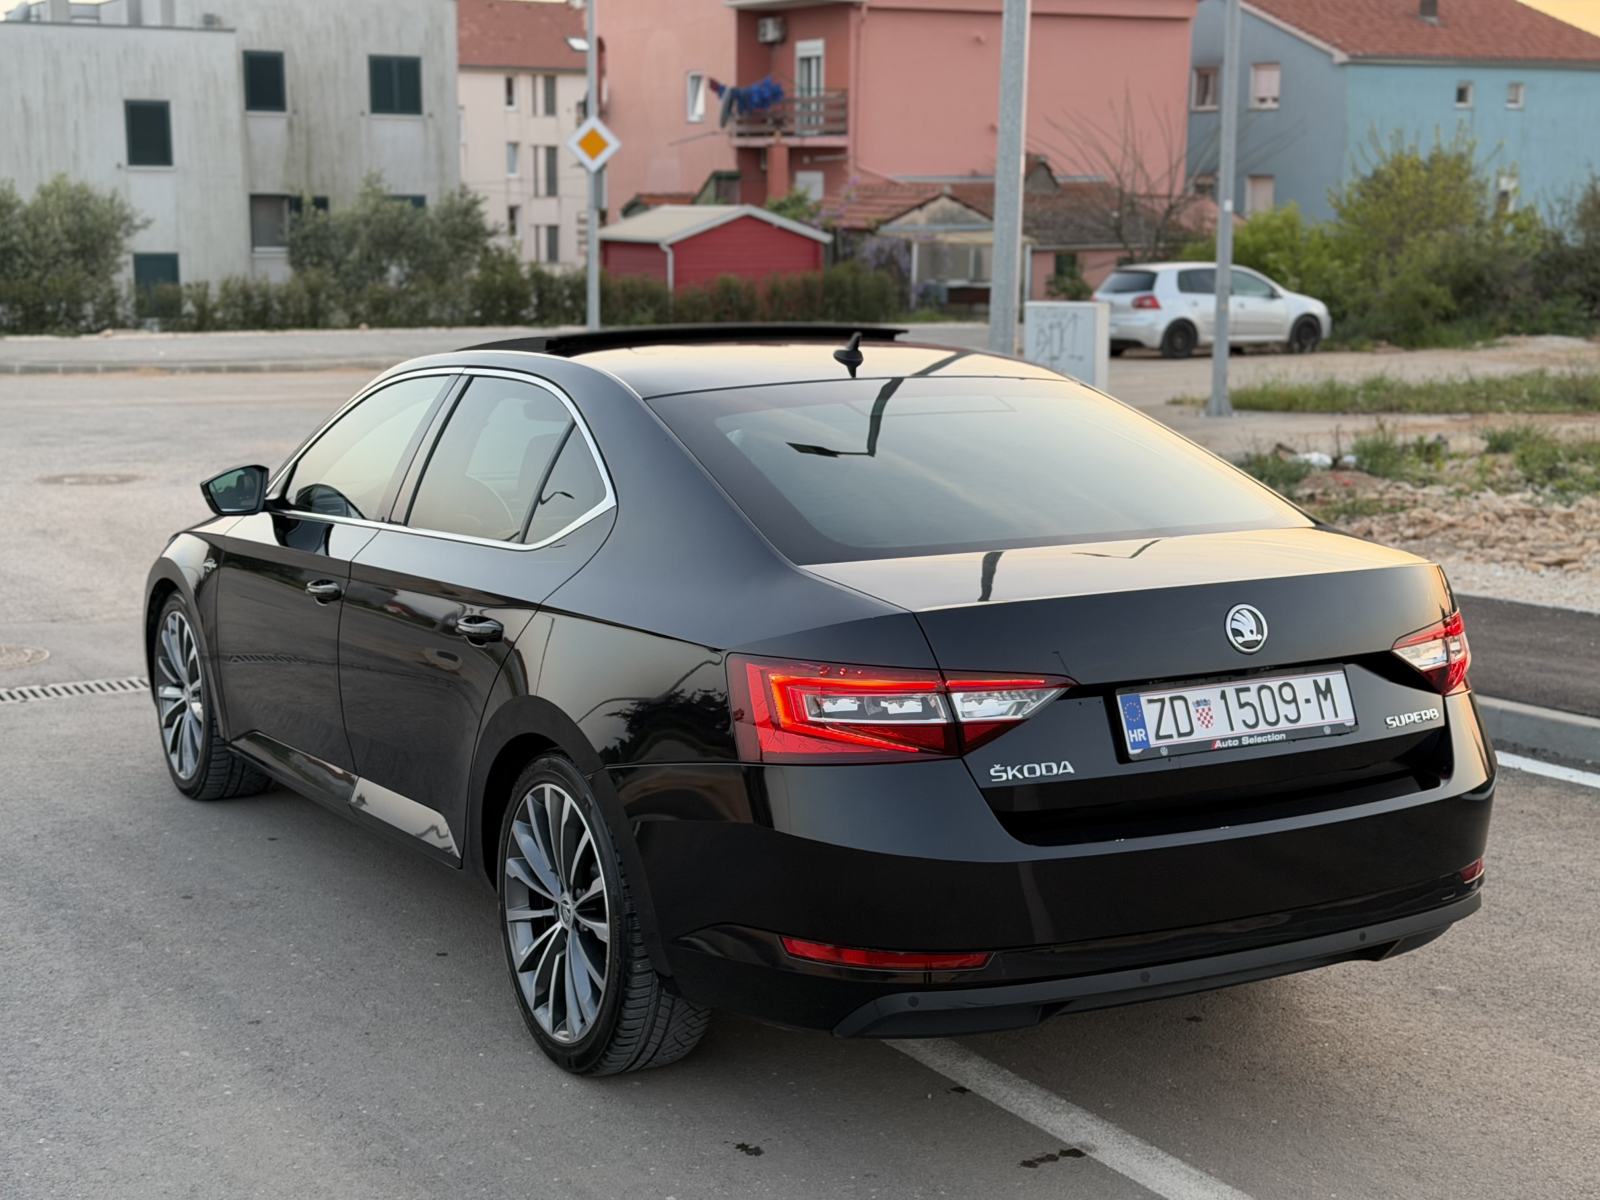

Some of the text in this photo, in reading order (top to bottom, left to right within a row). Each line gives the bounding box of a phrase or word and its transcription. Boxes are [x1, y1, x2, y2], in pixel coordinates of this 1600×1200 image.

[1147, 678, 1339, 741] ZD 1509-M
[1385, 708, 1440, 729] SUPERB
[1128, 728, 1148, 743] HR
[1214, 731, 1287, 749] Auto Selection
[989, 760, 1075, 782] ŠKODA
